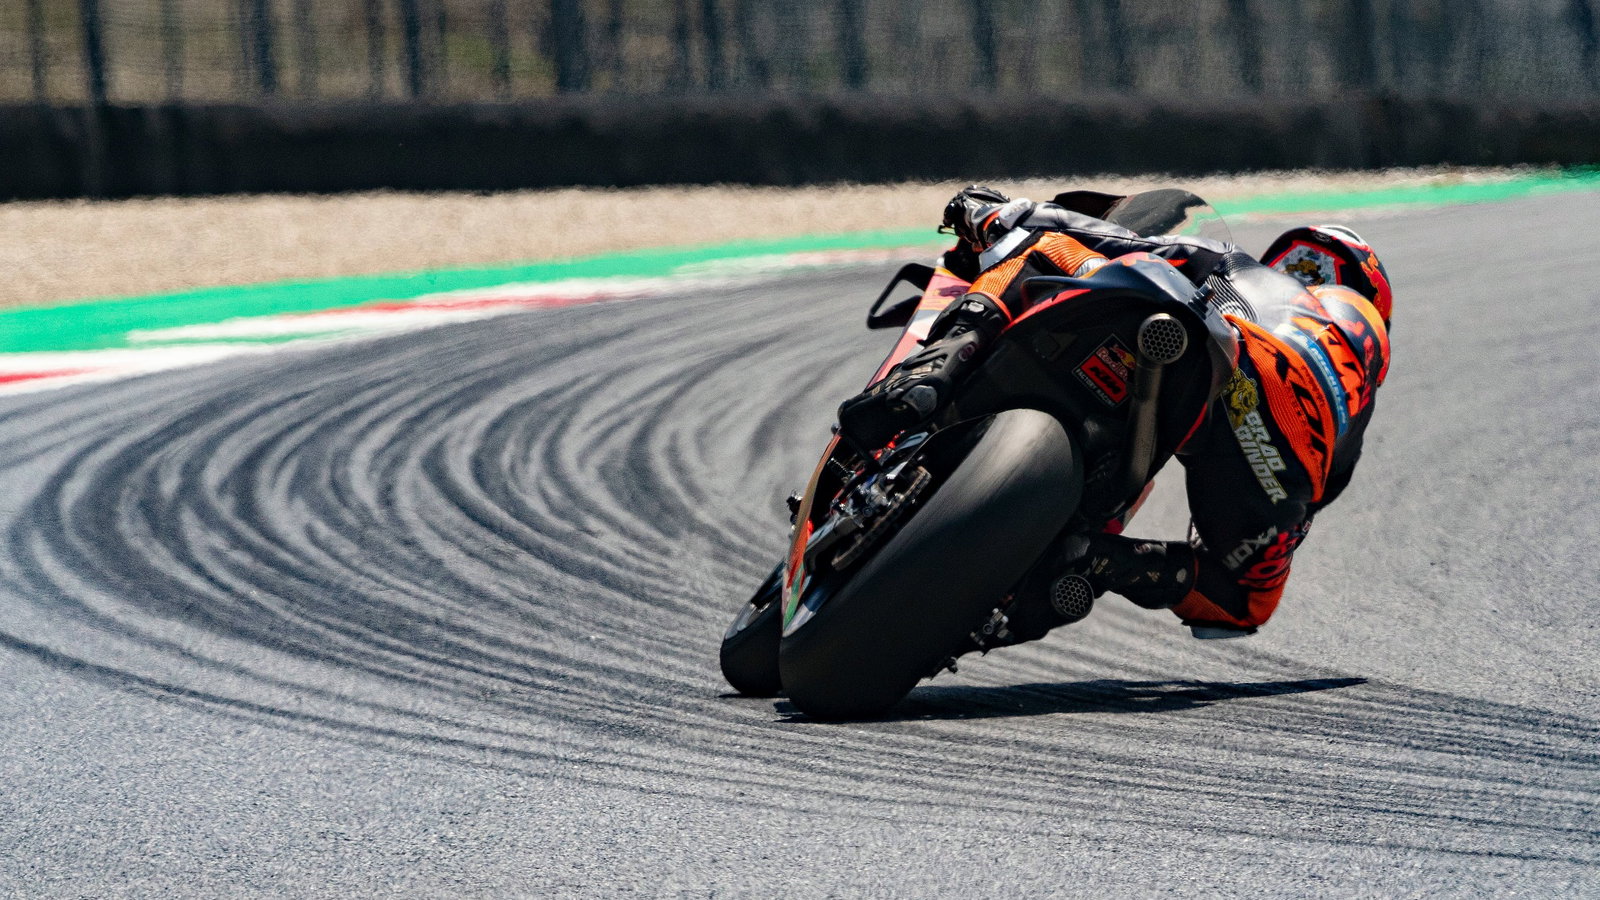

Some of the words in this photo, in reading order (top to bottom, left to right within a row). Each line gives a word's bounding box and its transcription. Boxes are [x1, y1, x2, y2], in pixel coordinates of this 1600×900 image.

[1090, 365, 1121, 394] KTM
[1290, 316, 1365, 416] KTM
[1311, 345, 1347, 424] MICHELIN
[1234, 425, 1288, 504] BINDER
[1245, 409, 1287, 471] BRAD
